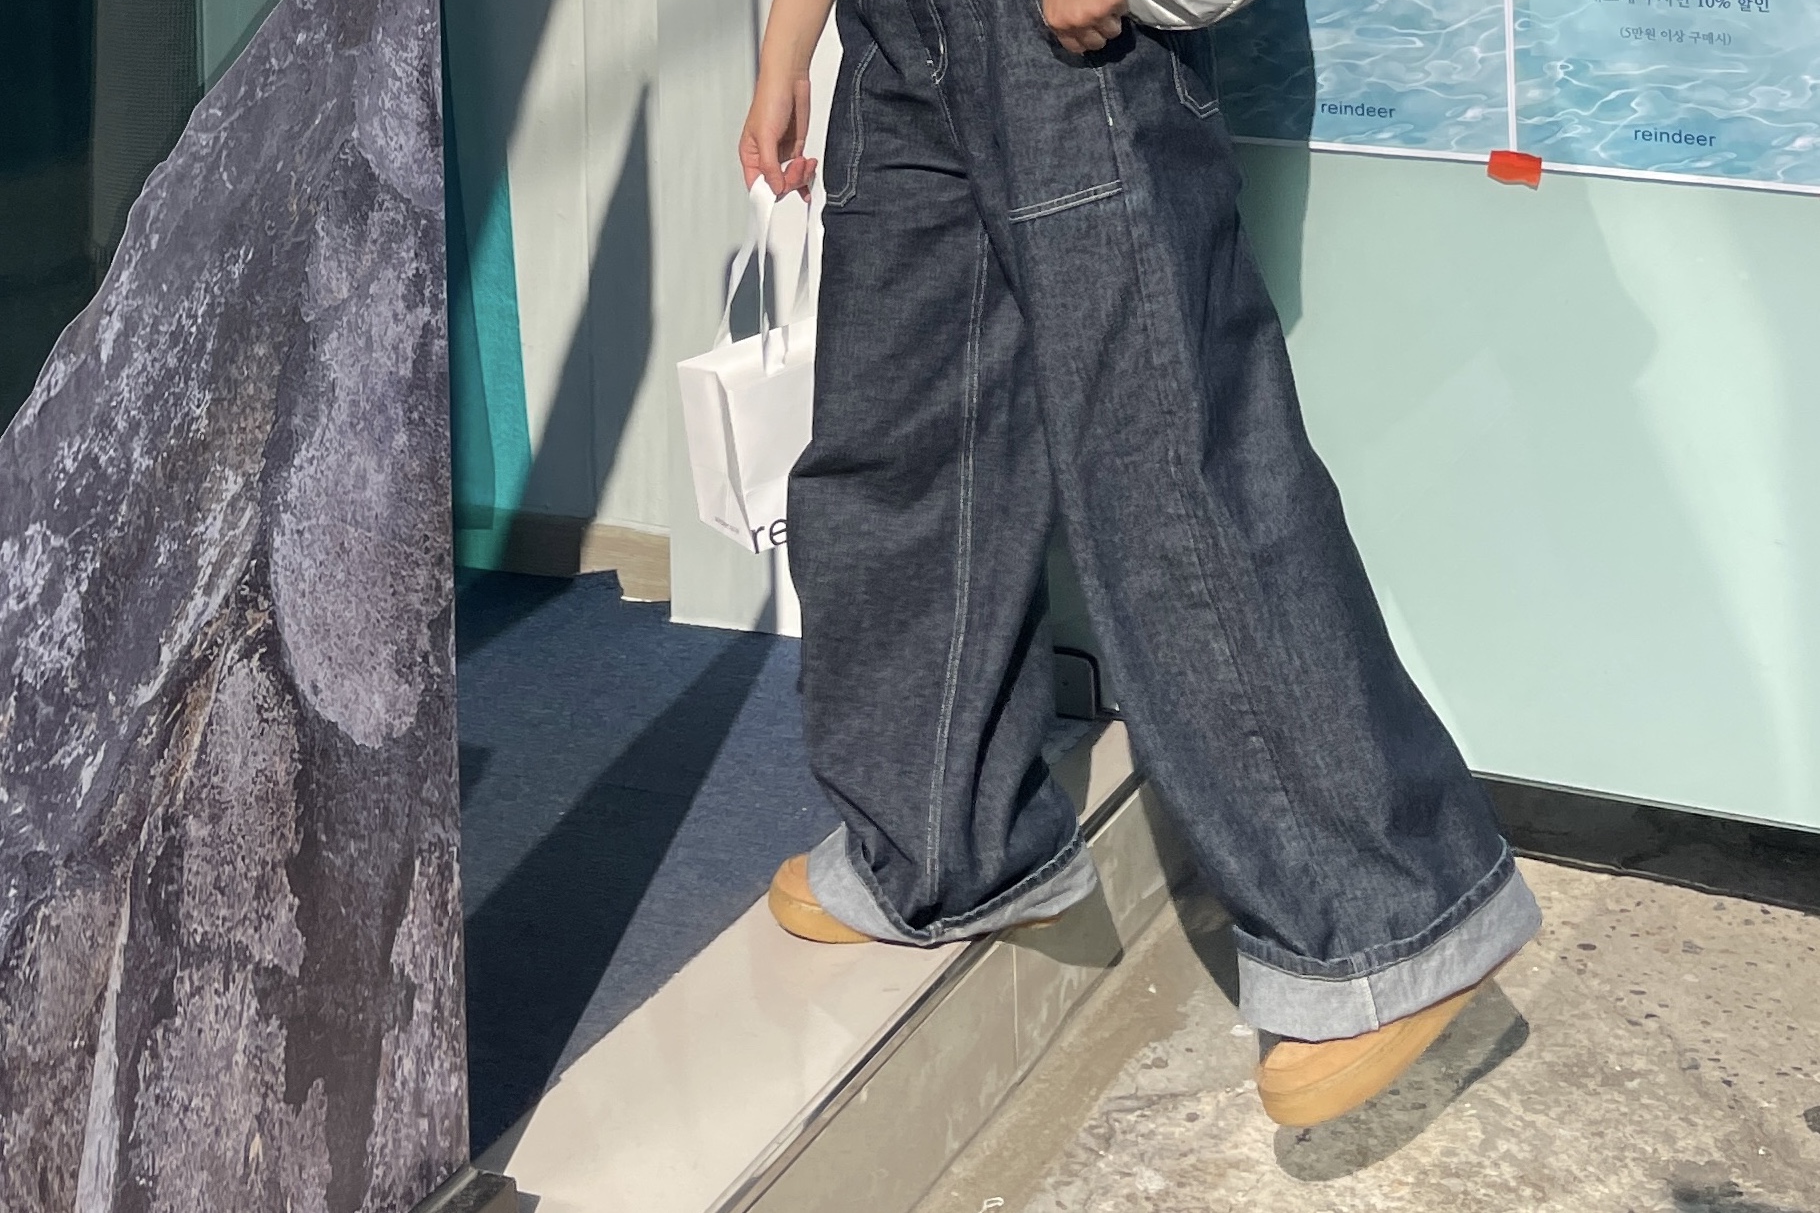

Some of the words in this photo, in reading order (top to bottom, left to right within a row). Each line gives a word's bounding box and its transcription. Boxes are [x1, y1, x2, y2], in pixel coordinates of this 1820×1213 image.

[1619, 27, 1656, 41] (5만원
[1660, 29, 1685, 43] 이상
[1689, 31, 1732, 46] 구매시)
[1321, 101, 1396, 118] reindeer
[1634, 127, 1716, 146] reindeer
